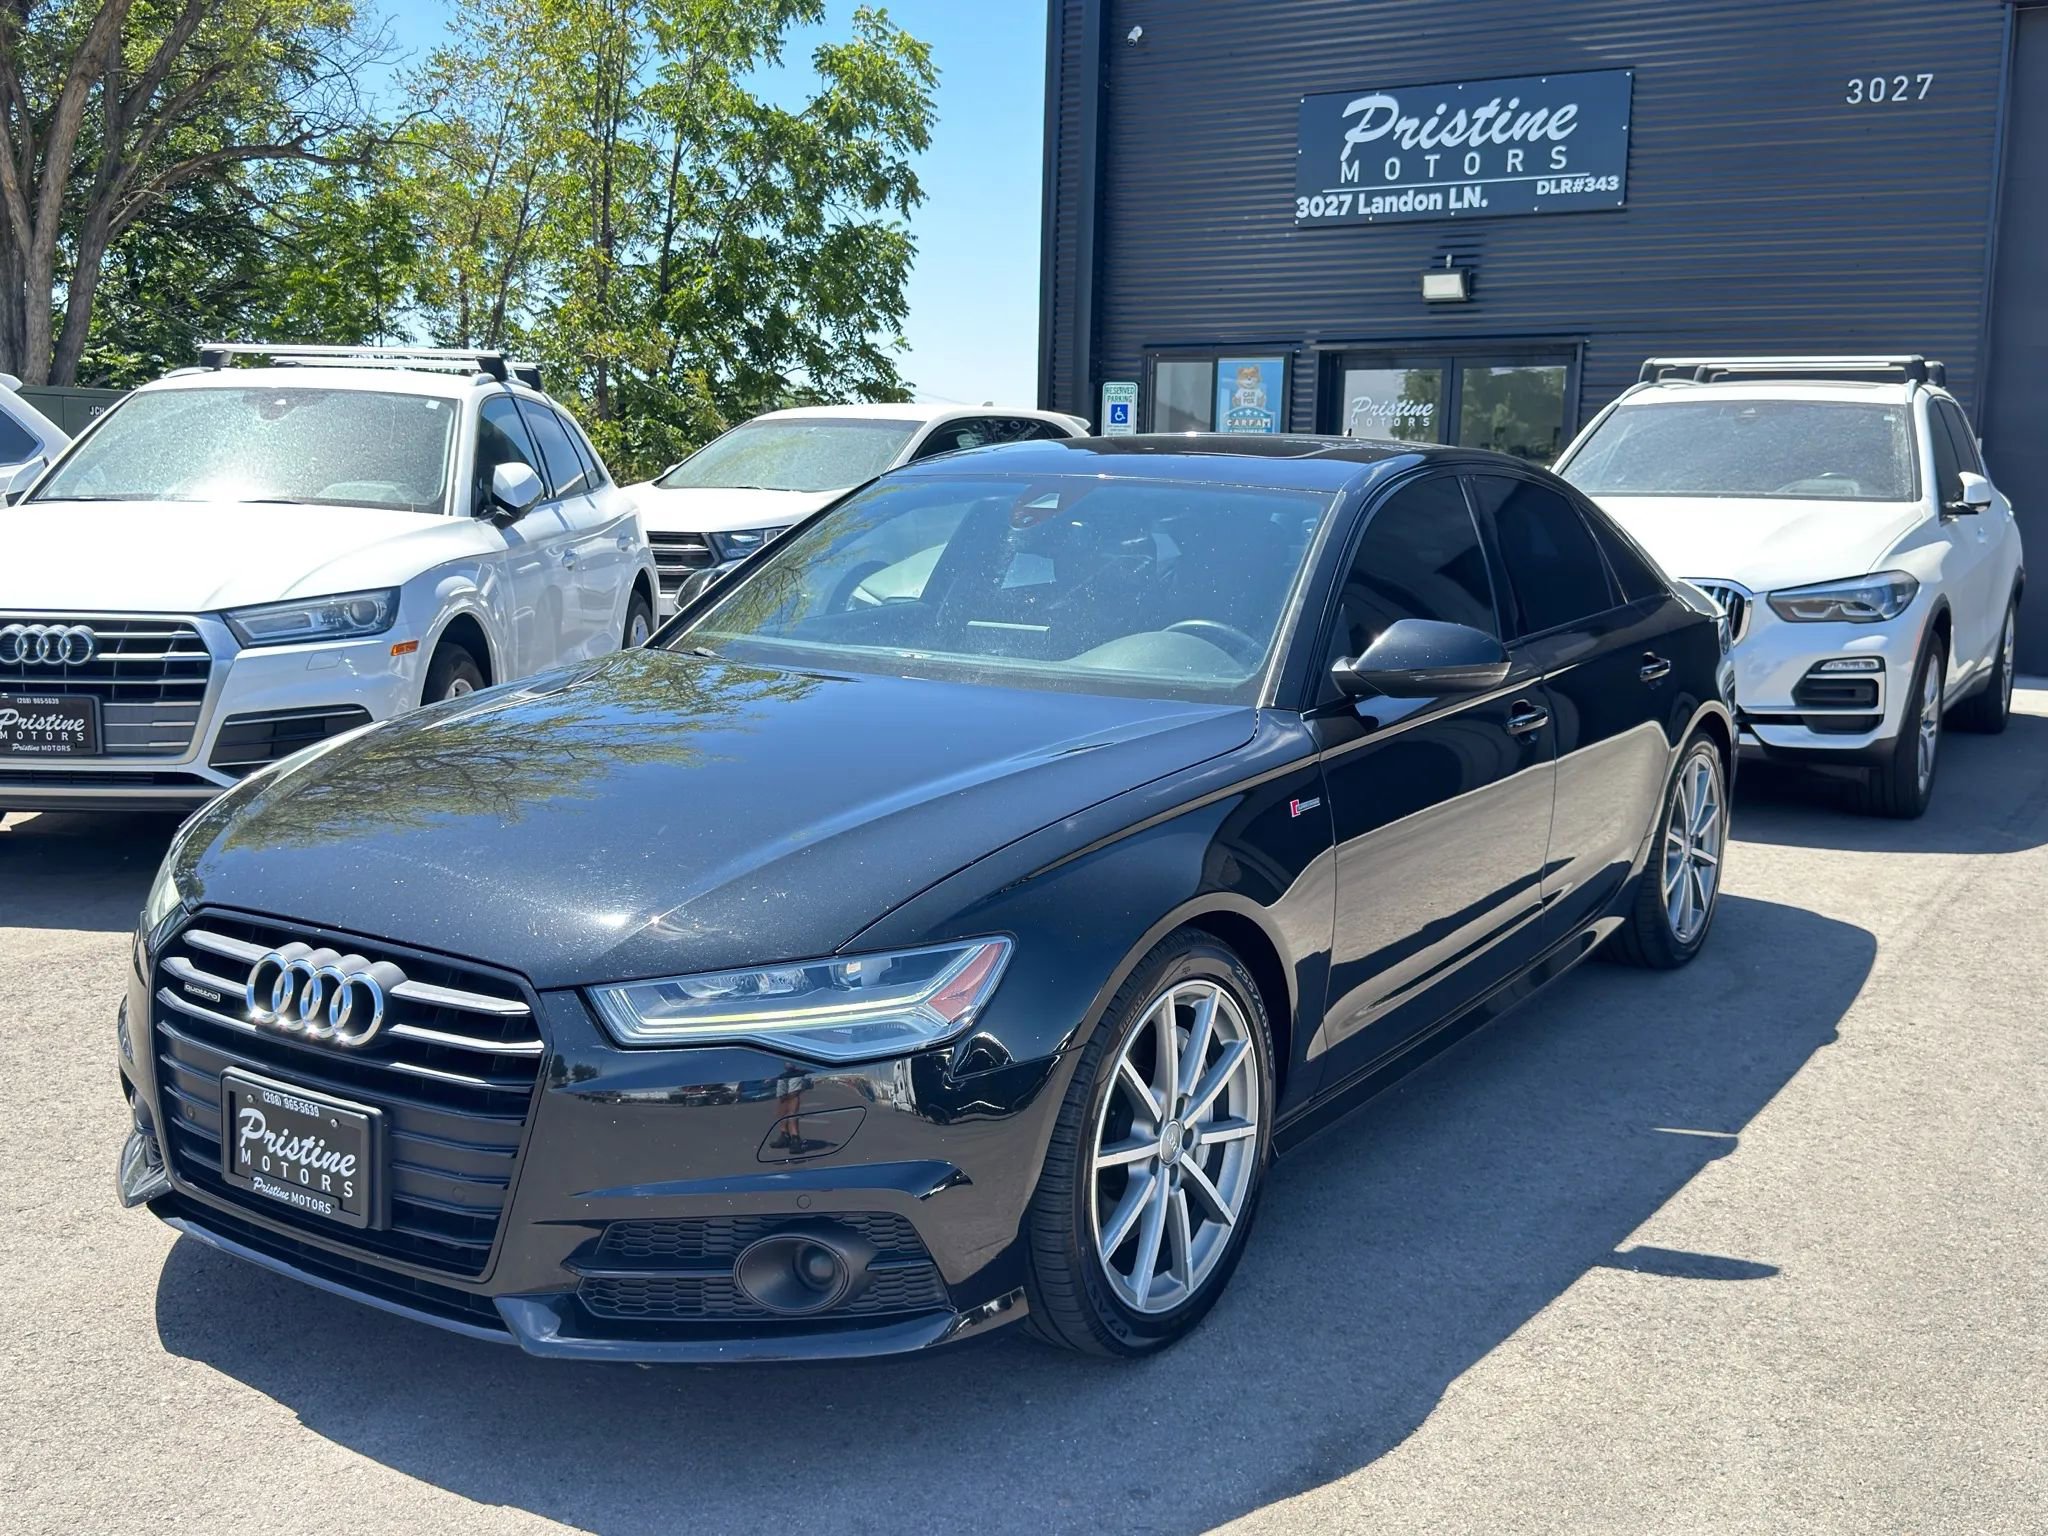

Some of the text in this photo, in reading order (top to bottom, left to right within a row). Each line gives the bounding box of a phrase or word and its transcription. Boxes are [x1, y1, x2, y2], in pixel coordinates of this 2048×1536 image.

[1846, 74, 1934, 104] 3027
[1340, 95, 1578, 162] Pristine
[1340, 146, 1567, 183] MOTORS
[1537, 176, 1619, 195] DLR#343
[1296, 186, 1489, 218] 3027 Landon LN.
[1351, 396, 1434, 419] Pristine
[1351, 417, 1430, 427] MOTORS
[0, 708, 85, 731] Pristine
[0, 730, 84, 742] MOTORS
[185, 984, 218, 1000] quattro
[263, 1090, 320, 1118] (208) 965-5639
[239, 1108, 356, 1177] Pristine
[241, 1148, 353, 1198] MOTORS
[253, 1176, 332, 1215] Pristine MOTORS
